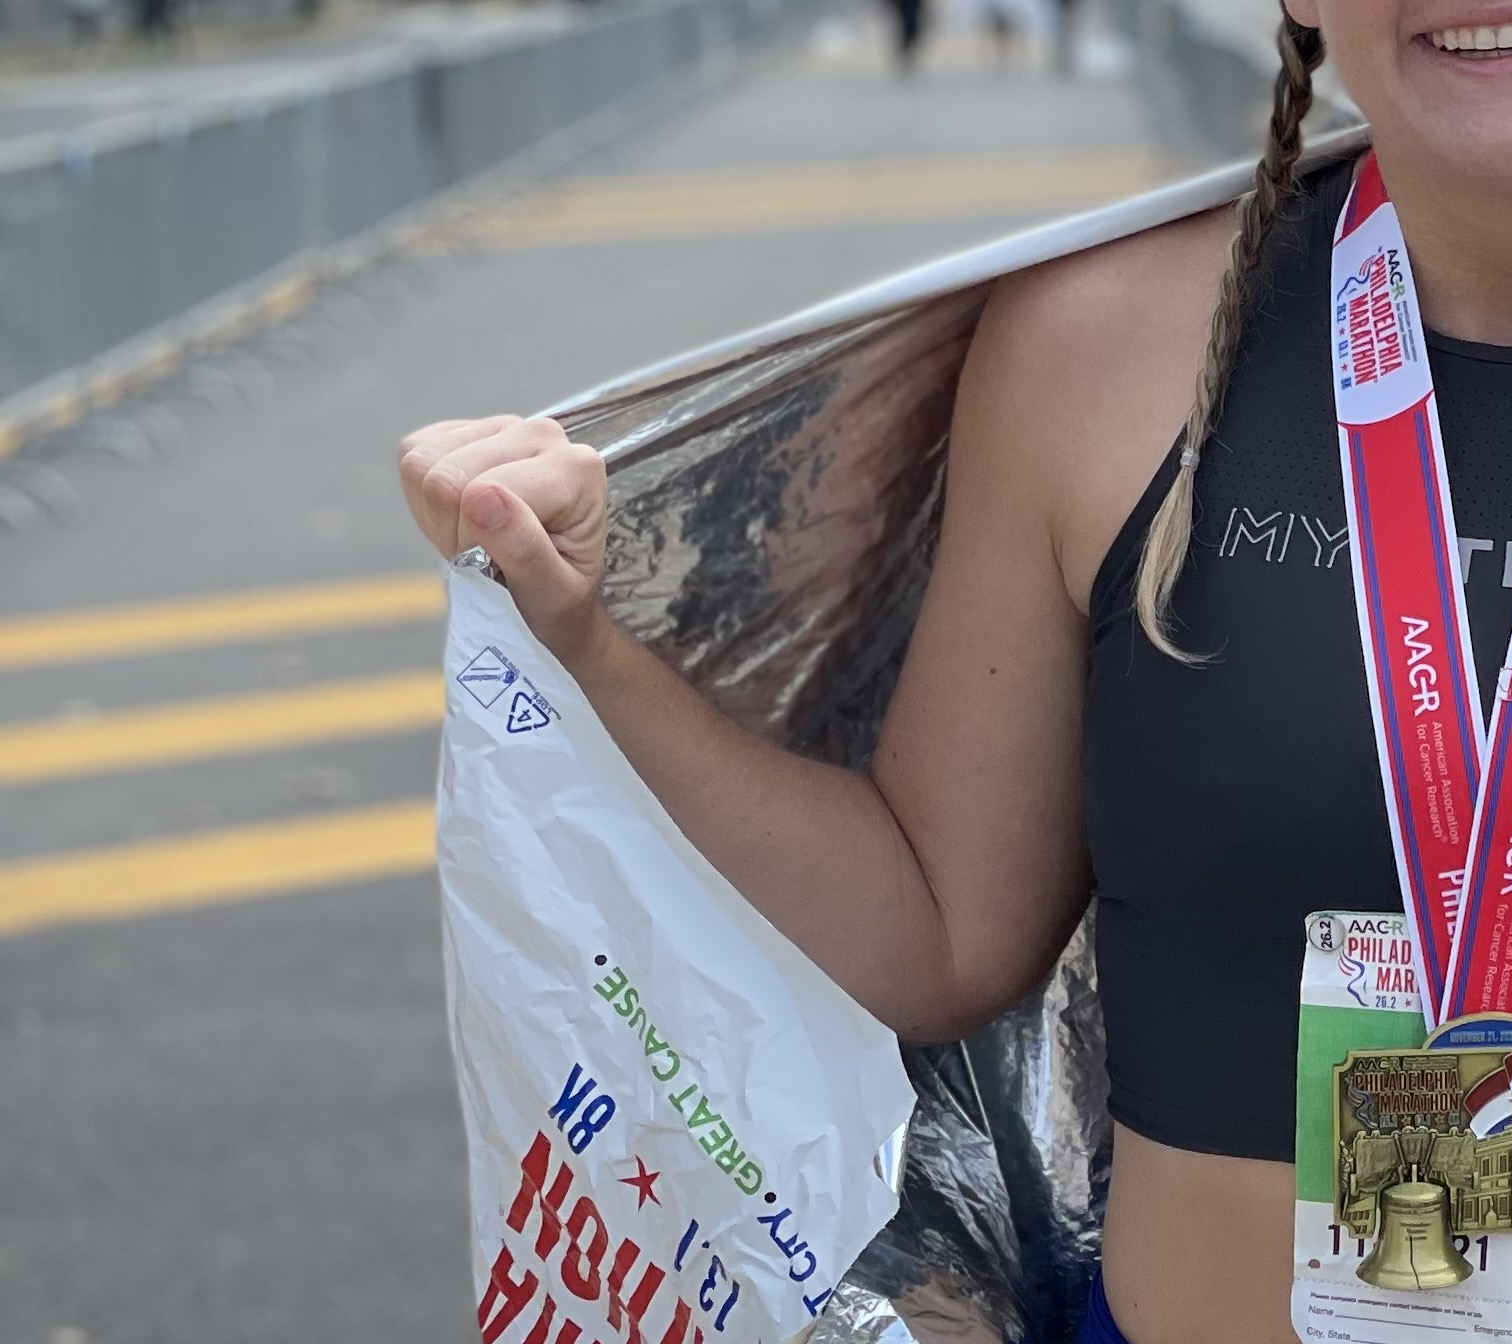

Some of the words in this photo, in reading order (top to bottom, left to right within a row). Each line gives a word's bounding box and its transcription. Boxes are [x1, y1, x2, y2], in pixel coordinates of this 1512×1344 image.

[1387, 249, 1406, 301] AACR
[1370, 253, 1403, 377] PHILADELPHIA
[1349, 293, 1377, 385] MARATHON
[1400, 616, 1440, 717] AACR
[1416, 723, 1427, 740] for
[1419, 743, 1433, 783] Cancer
[1432, 721, 1448, 776] American
[1441, 779, 1460, 845] Association
[1498, 904, 1509, 920] for
[1320, 920, 1333, 950] 26.2
[1348, 919, 1405, 935] AACR
[1347, 937, 1415, 966] PHILAD
[1488, 921, 1505, 964] Cancer
[1376, 967, 1419, 993] MAR
[1375, 996, 1396, 1009] 26.2
[1355, 1069, 1460, 1092] PHILADELPHIA
[547, 1062, 616, 1155] 8K
[1378, 1090, 1460, 1115] MARATHON
[668, 1083, 763, 1196] GREAT
[1308, 1306, 1334, 1317] Name
[1328, 1330, 1351, 1341] State
